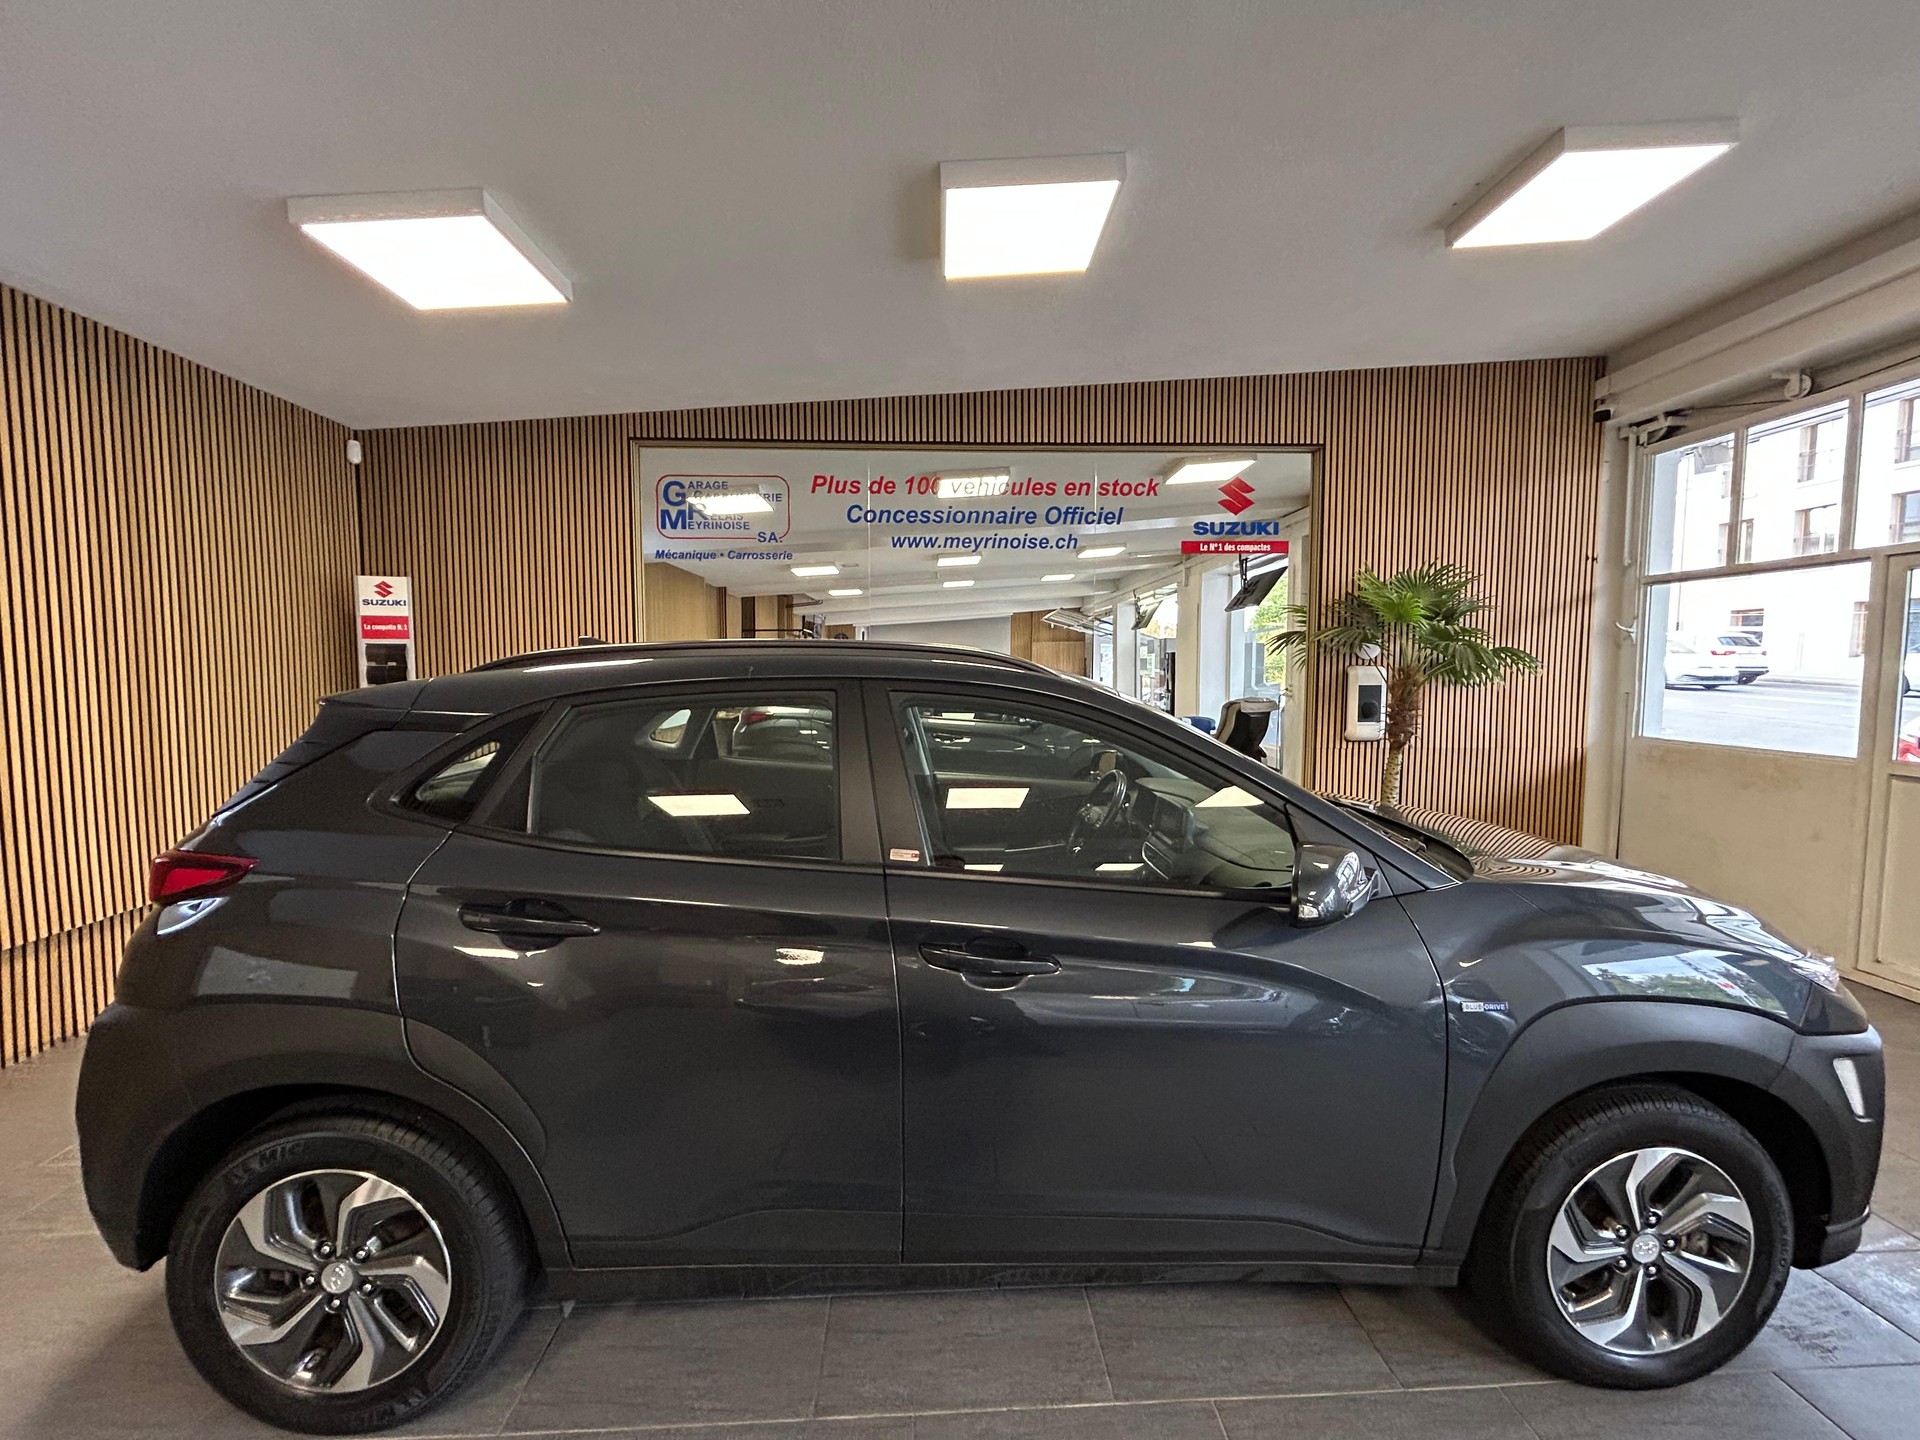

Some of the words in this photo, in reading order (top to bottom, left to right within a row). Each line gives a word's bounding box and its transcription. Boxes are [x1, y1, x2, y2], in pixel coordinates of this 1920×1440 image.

[810, 475, 861, 495] Plus
[869, 476, 896, 495] de
[1064, 481, 1091, 496] en
[1097, 478, 1160, 497] stock
[847, 504, 1037, 525] Concessionnaire
[1045, 506, 1124, 525] Officiel
[1193, 521, 1279, 536] SUZUKI
[757, 532, 783, 543] SA.
[891, 533, 1078, 553] www.meyrinoise.ch
[1200, 542, 1208, 551] Le
[1224, 542, 1235, 551] des
[1236, 543, 1271, 552] compactes
[655, 550, 717, 562] Mécanique
[727, 550, 793, 560] Carrosserie
[362, 598, 407, 607] SUZUKI
